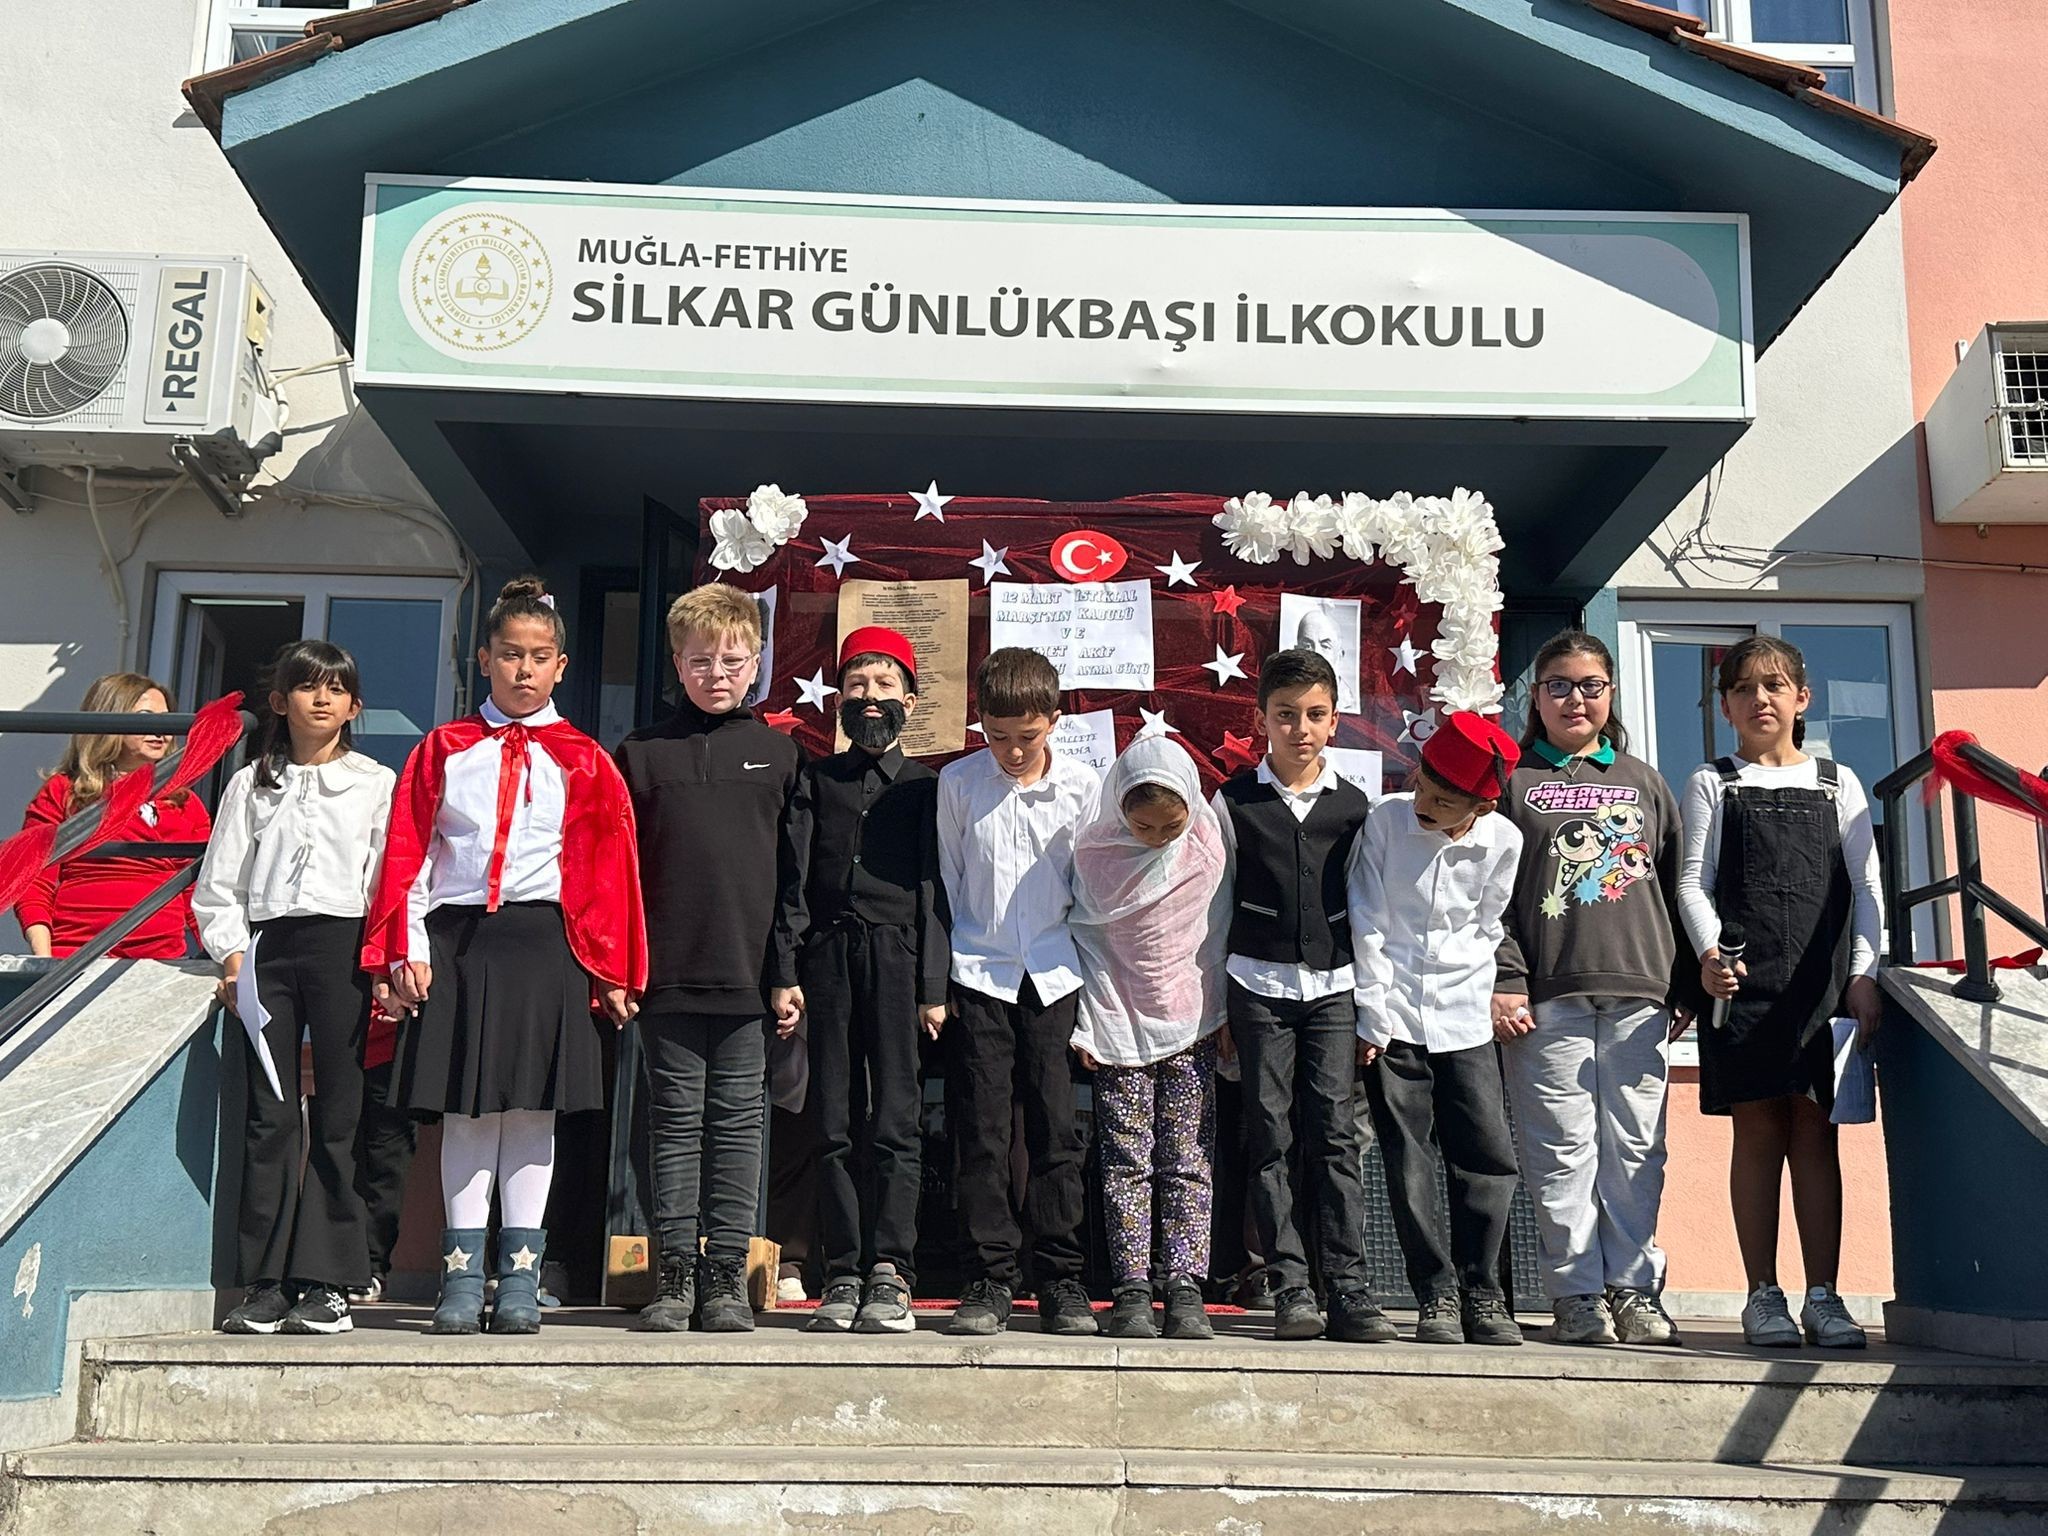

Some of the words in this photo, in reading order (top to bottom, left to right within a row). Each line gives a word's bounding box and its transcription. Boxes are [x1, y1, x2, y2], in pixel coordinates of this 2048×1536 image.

[577, 235, 848, 273] MUĞLA-FETHİYE
[571, 272, 794, 330] SİLKAR
[811, 282, 1215, 353] GÜNLÜKBAŞI
[1236, 292, 1544, 348] İLKOKULU
[162, 271, 208, 399] REGAL
[1002, 591, 1019, 603] 12
[1021, 591, 1062, 604] MART
[1077, 607, 1134, 620] KABULÜ
[1078, 645, 1115, 658] AKİF
[1076, 664, 1113, 676] ANMA
[1115, 662, 1150, 675] GÜNÜ
[1529, 787, 1636, 801] POWERPUFF
